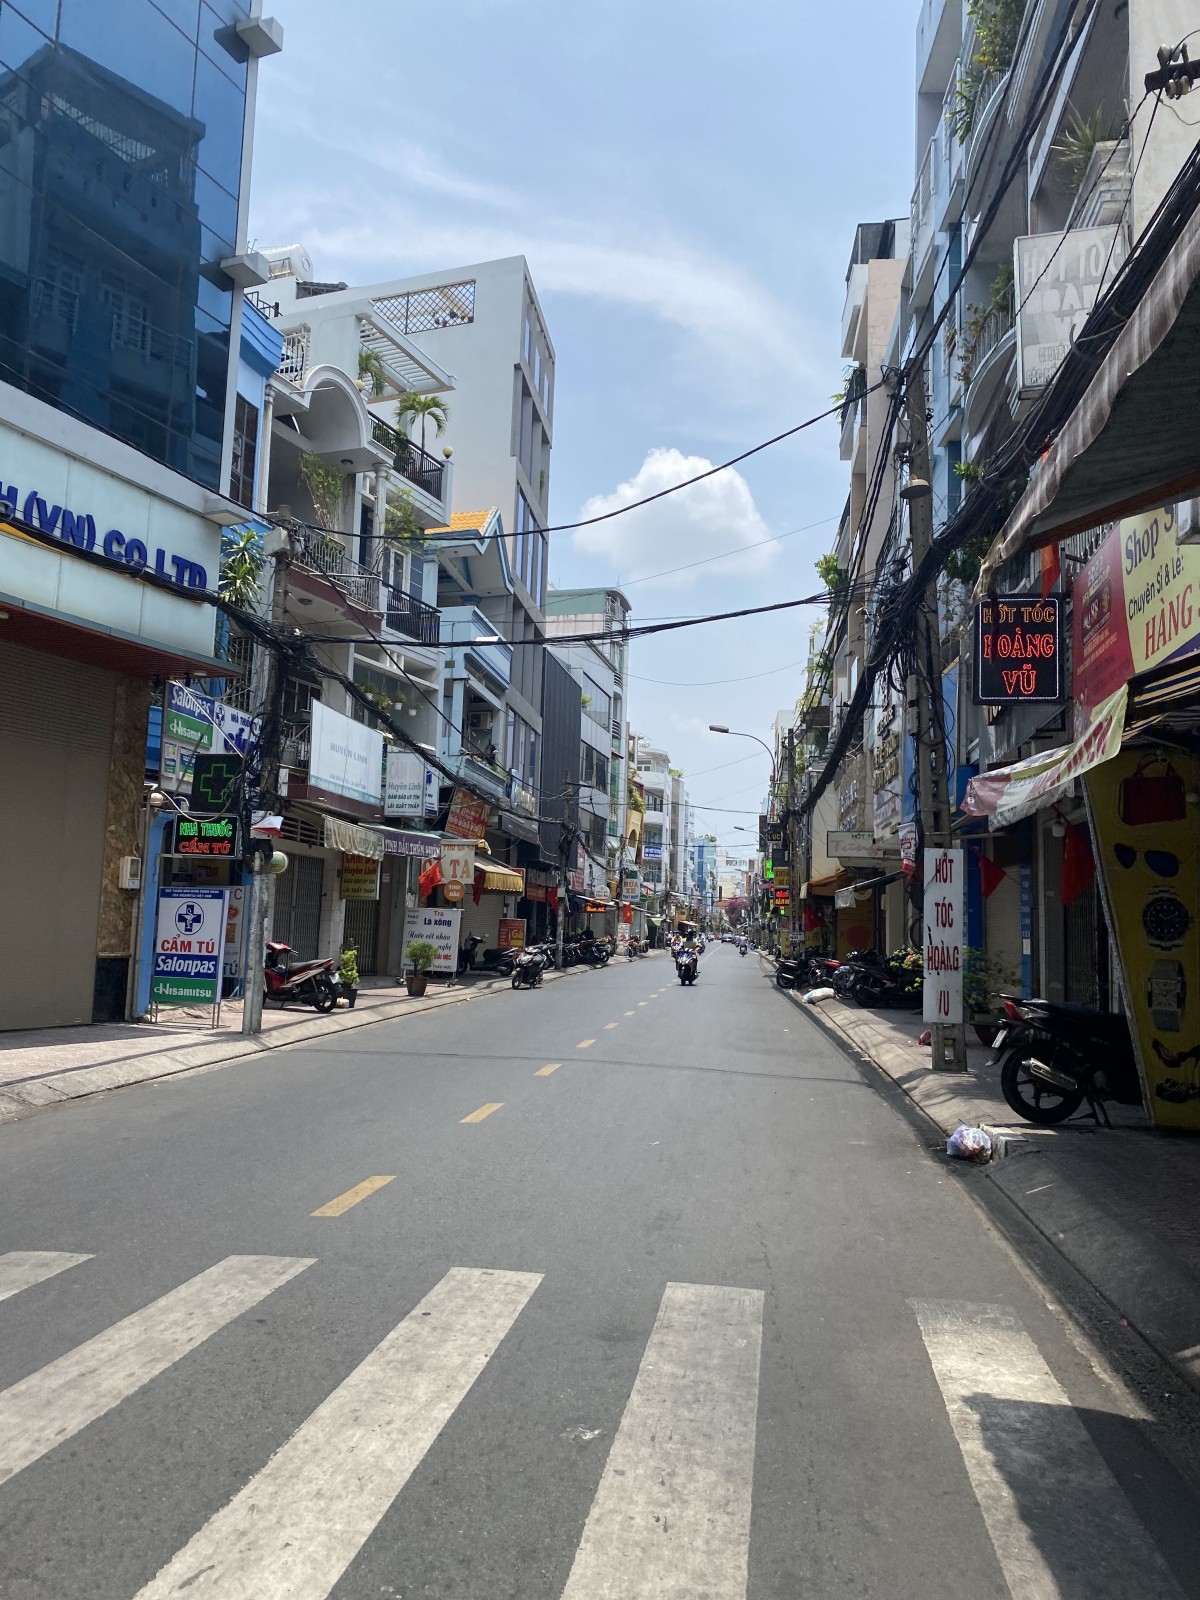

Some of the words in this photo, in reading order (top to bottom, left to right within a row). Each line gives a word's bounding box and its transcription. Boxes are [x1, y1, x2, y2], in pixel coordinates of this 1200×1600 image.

[1125, 517, 1159, 576] Shop
[1021, 603, 1055, 623] TÓC
[1128, 582, 1156, 621] Chuyên
[1144, 584, 1194, 661] HÀNG
[1002, 664, 1037, 695] VŨ
[171, 685, 211, 717] Salonpas
[388, 781, 407, 793] Huyền
[408, 782, 422, 791] Linh
[934, 853, 954, 883] HỚT
[934, 896, 954, 928] TÓC
[160, 933, 192, 954] CẨM
[197, 938, 215, 954] TÚ
[155, 955, 217, 976] Salonpas
[153, 983, 213, 999] Hisamitsu
